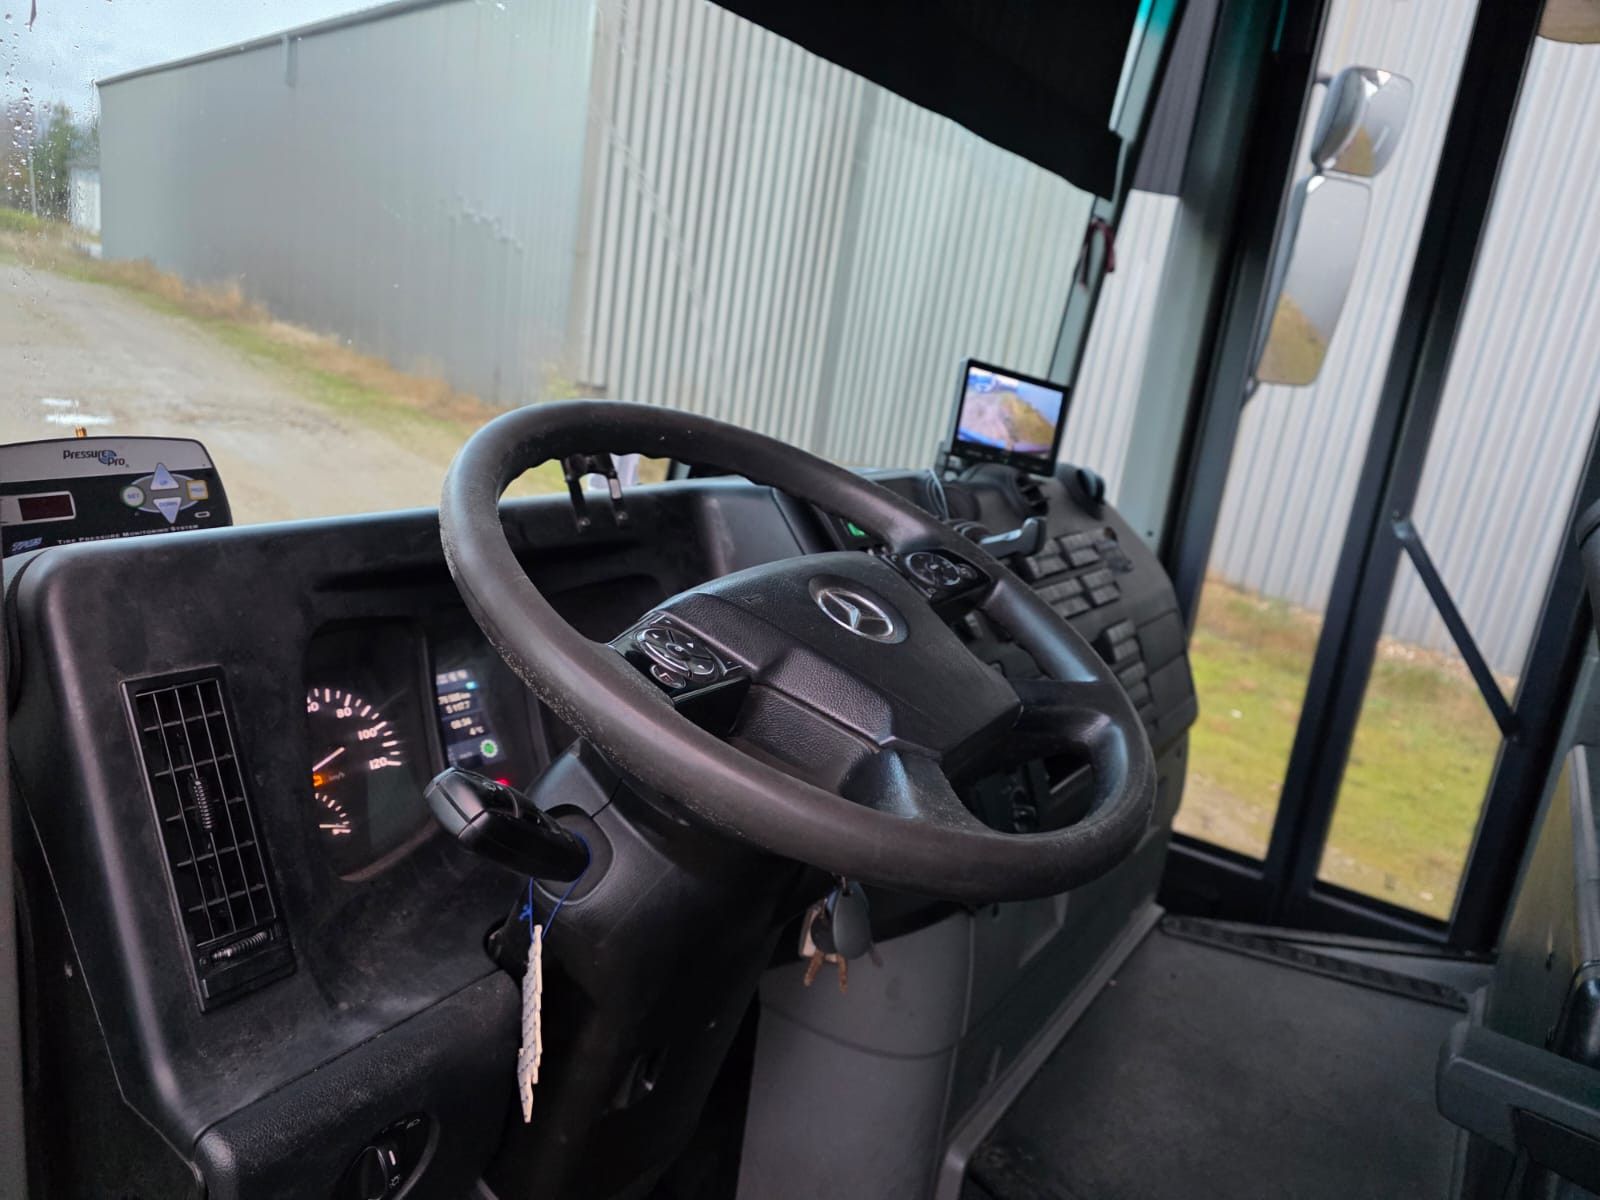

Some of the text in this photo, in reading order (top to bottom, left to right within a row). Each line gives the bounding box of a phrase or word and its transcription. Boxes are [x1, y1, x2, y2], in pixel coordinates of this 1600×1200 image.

[336, 707, 353, 719] 80
[358, 727, 378, 741] 100
[369, 756, 389, 771] 120
